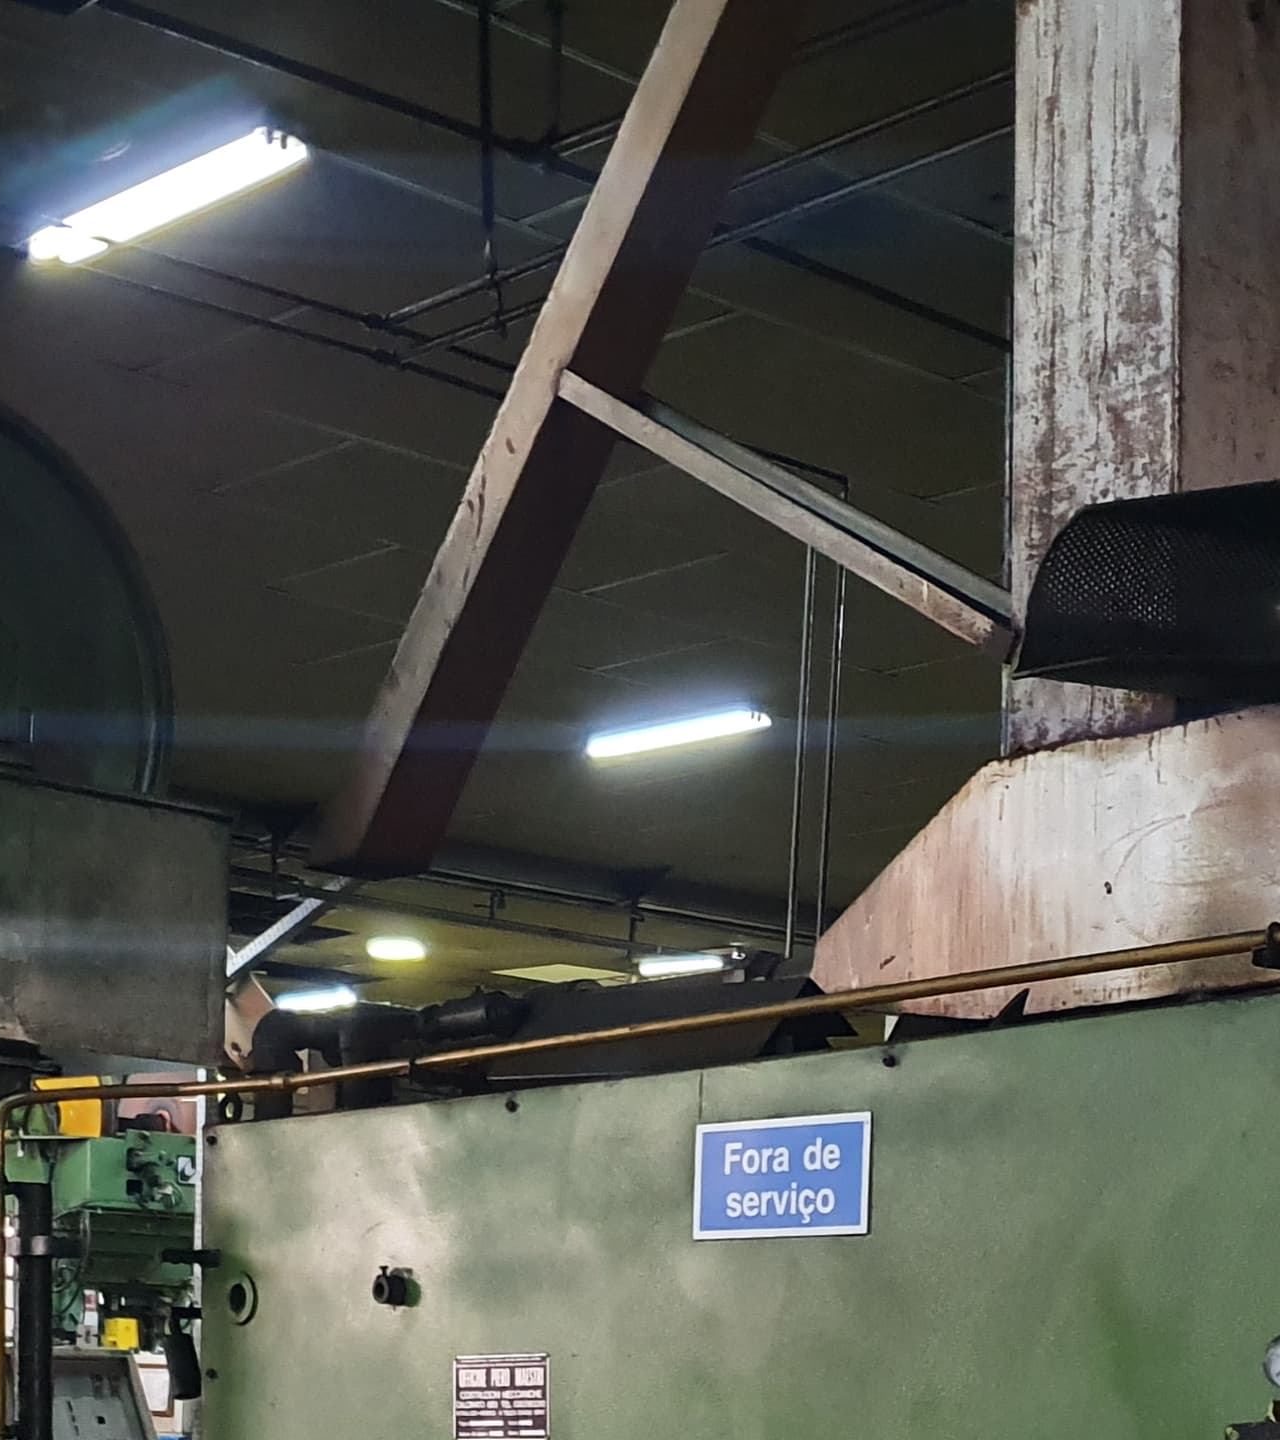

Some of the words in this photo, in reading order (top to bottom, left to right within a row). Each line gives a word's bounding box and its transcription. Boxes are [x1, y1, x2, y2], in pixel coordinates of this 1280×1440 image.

[724, 1141, 790, 1176] Fora
[803, 1137, 841, 1171] de
[725, 1181, 836, 1224] serviço
